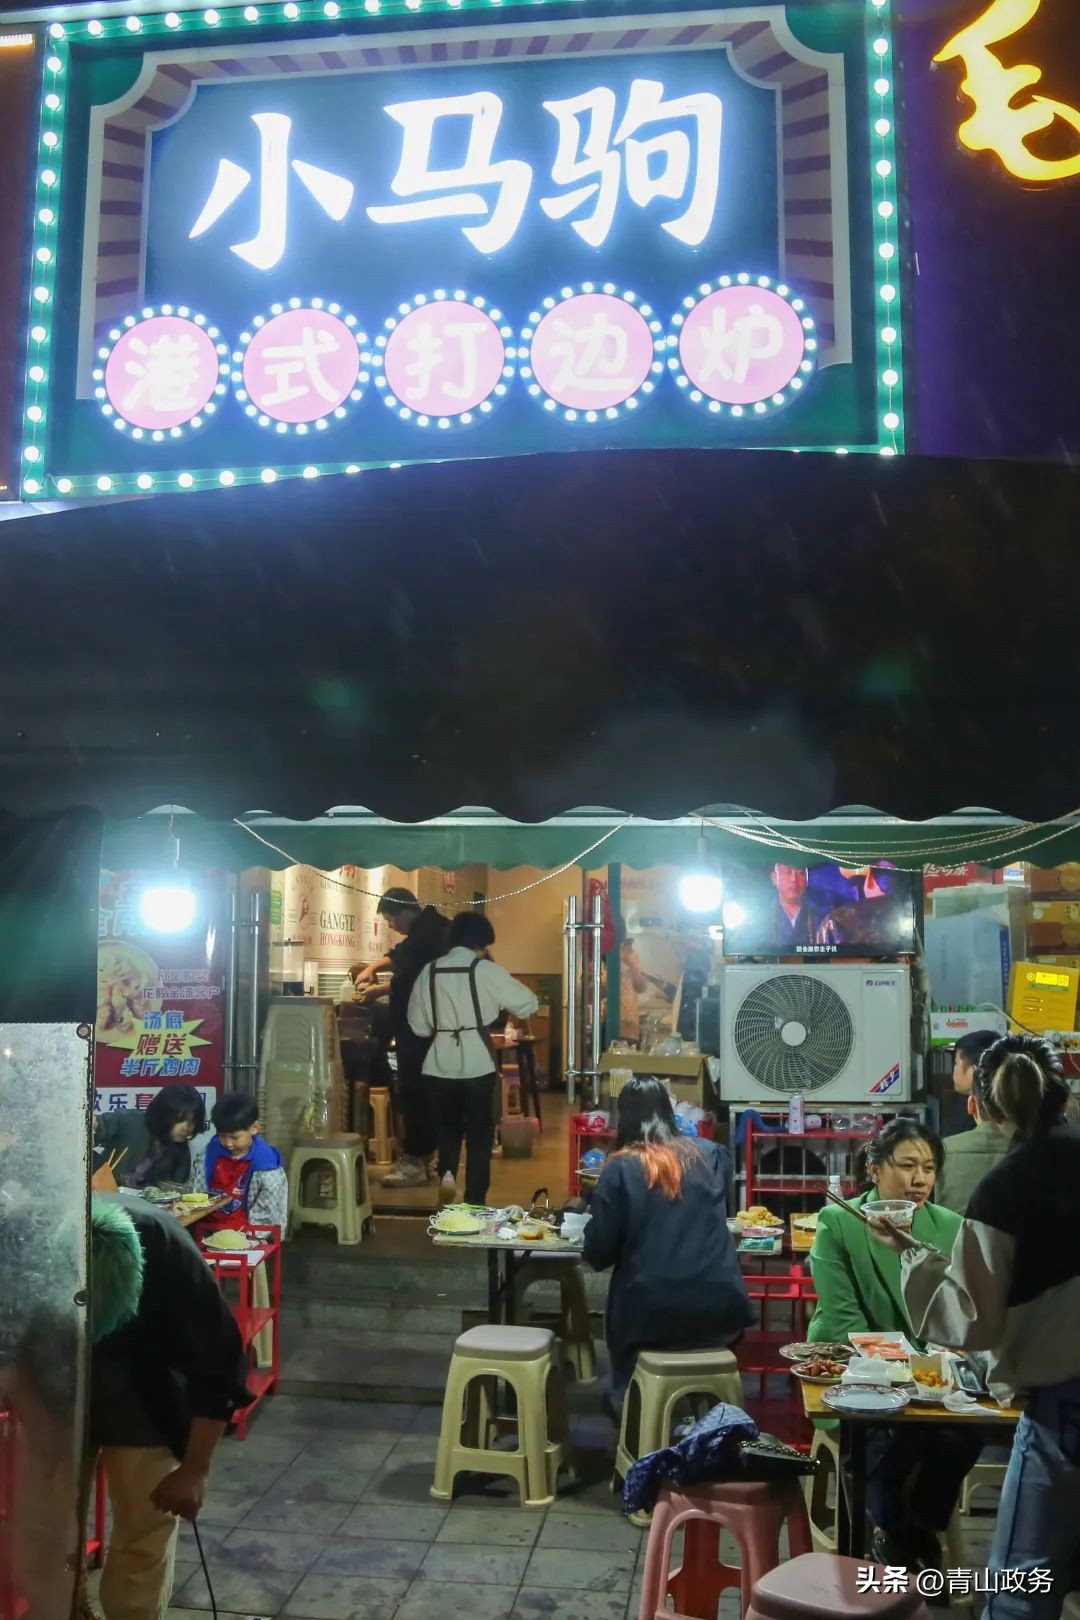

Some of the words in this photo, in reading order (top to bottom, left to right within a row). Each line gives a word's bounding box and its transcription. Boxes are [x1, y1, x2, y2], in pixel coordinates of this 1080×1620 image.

[189, 78, 723, 271] 小马驹
[123, 303, 784, 412] 港式打边炉
[143, 1009, 184, 1029] 汤底
[136, 1033, 187, 1056] 赠送
[120, 1057, 201, 1077] 半斤鸡肉
